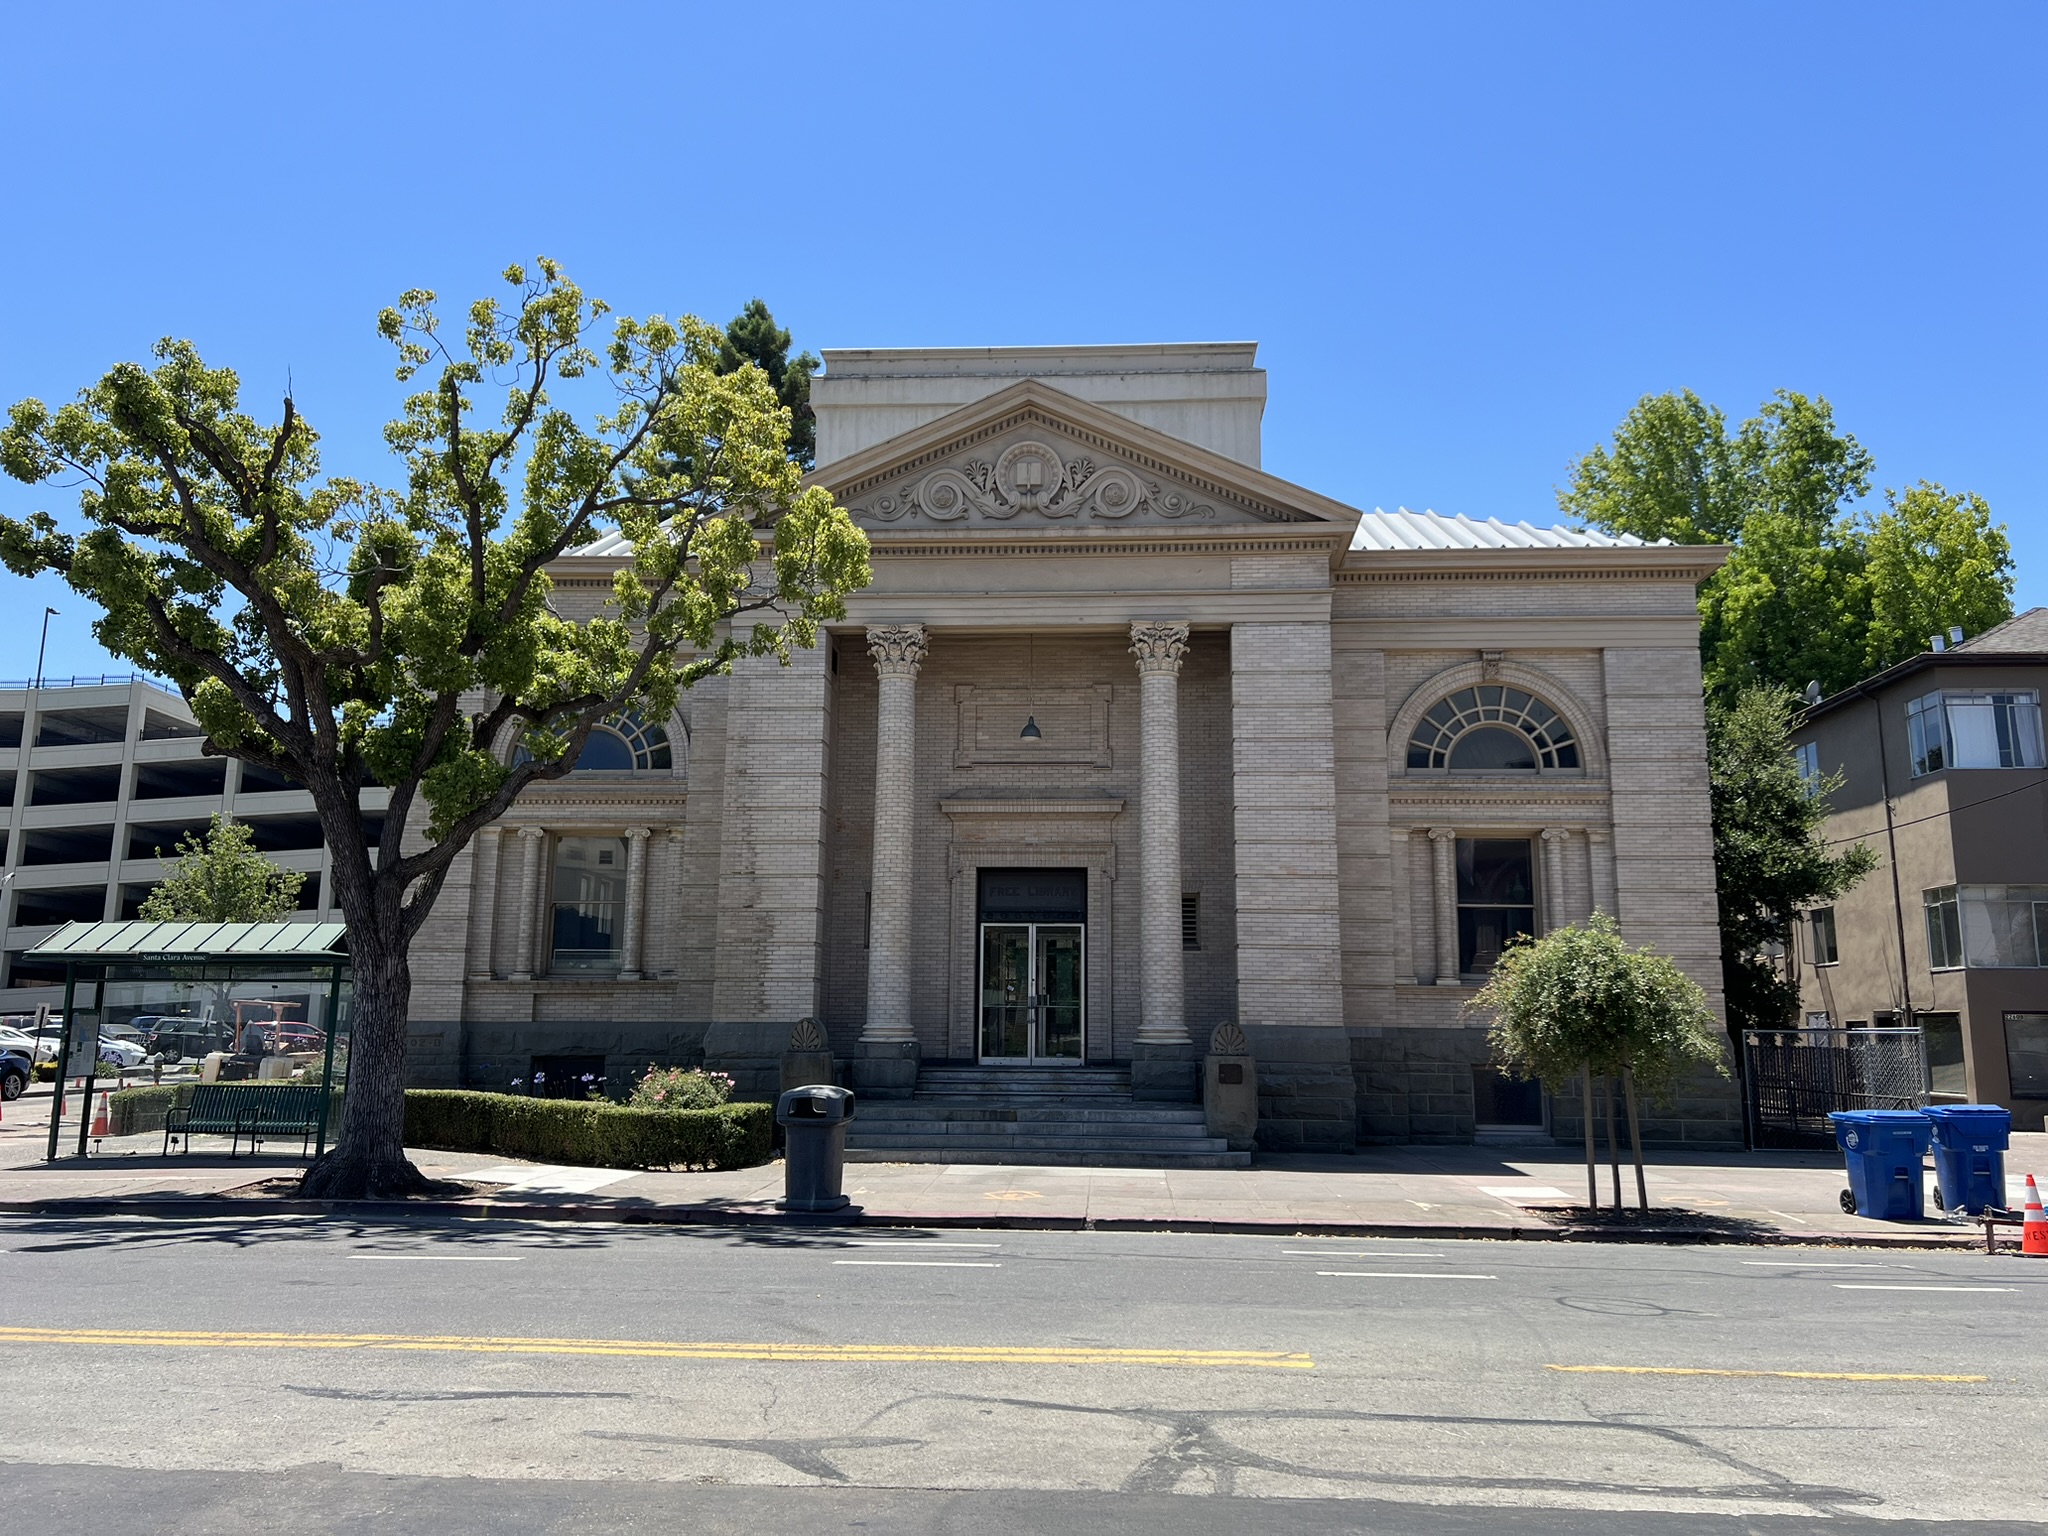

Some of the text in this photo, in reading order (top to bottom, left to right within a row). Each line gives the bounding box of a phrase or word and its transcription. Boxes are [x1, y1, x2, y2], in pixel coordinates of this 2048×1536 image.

[991, 887, 1077, 897] FREE LIBRARY
[2025, 1231, 2048, 1241] WES
